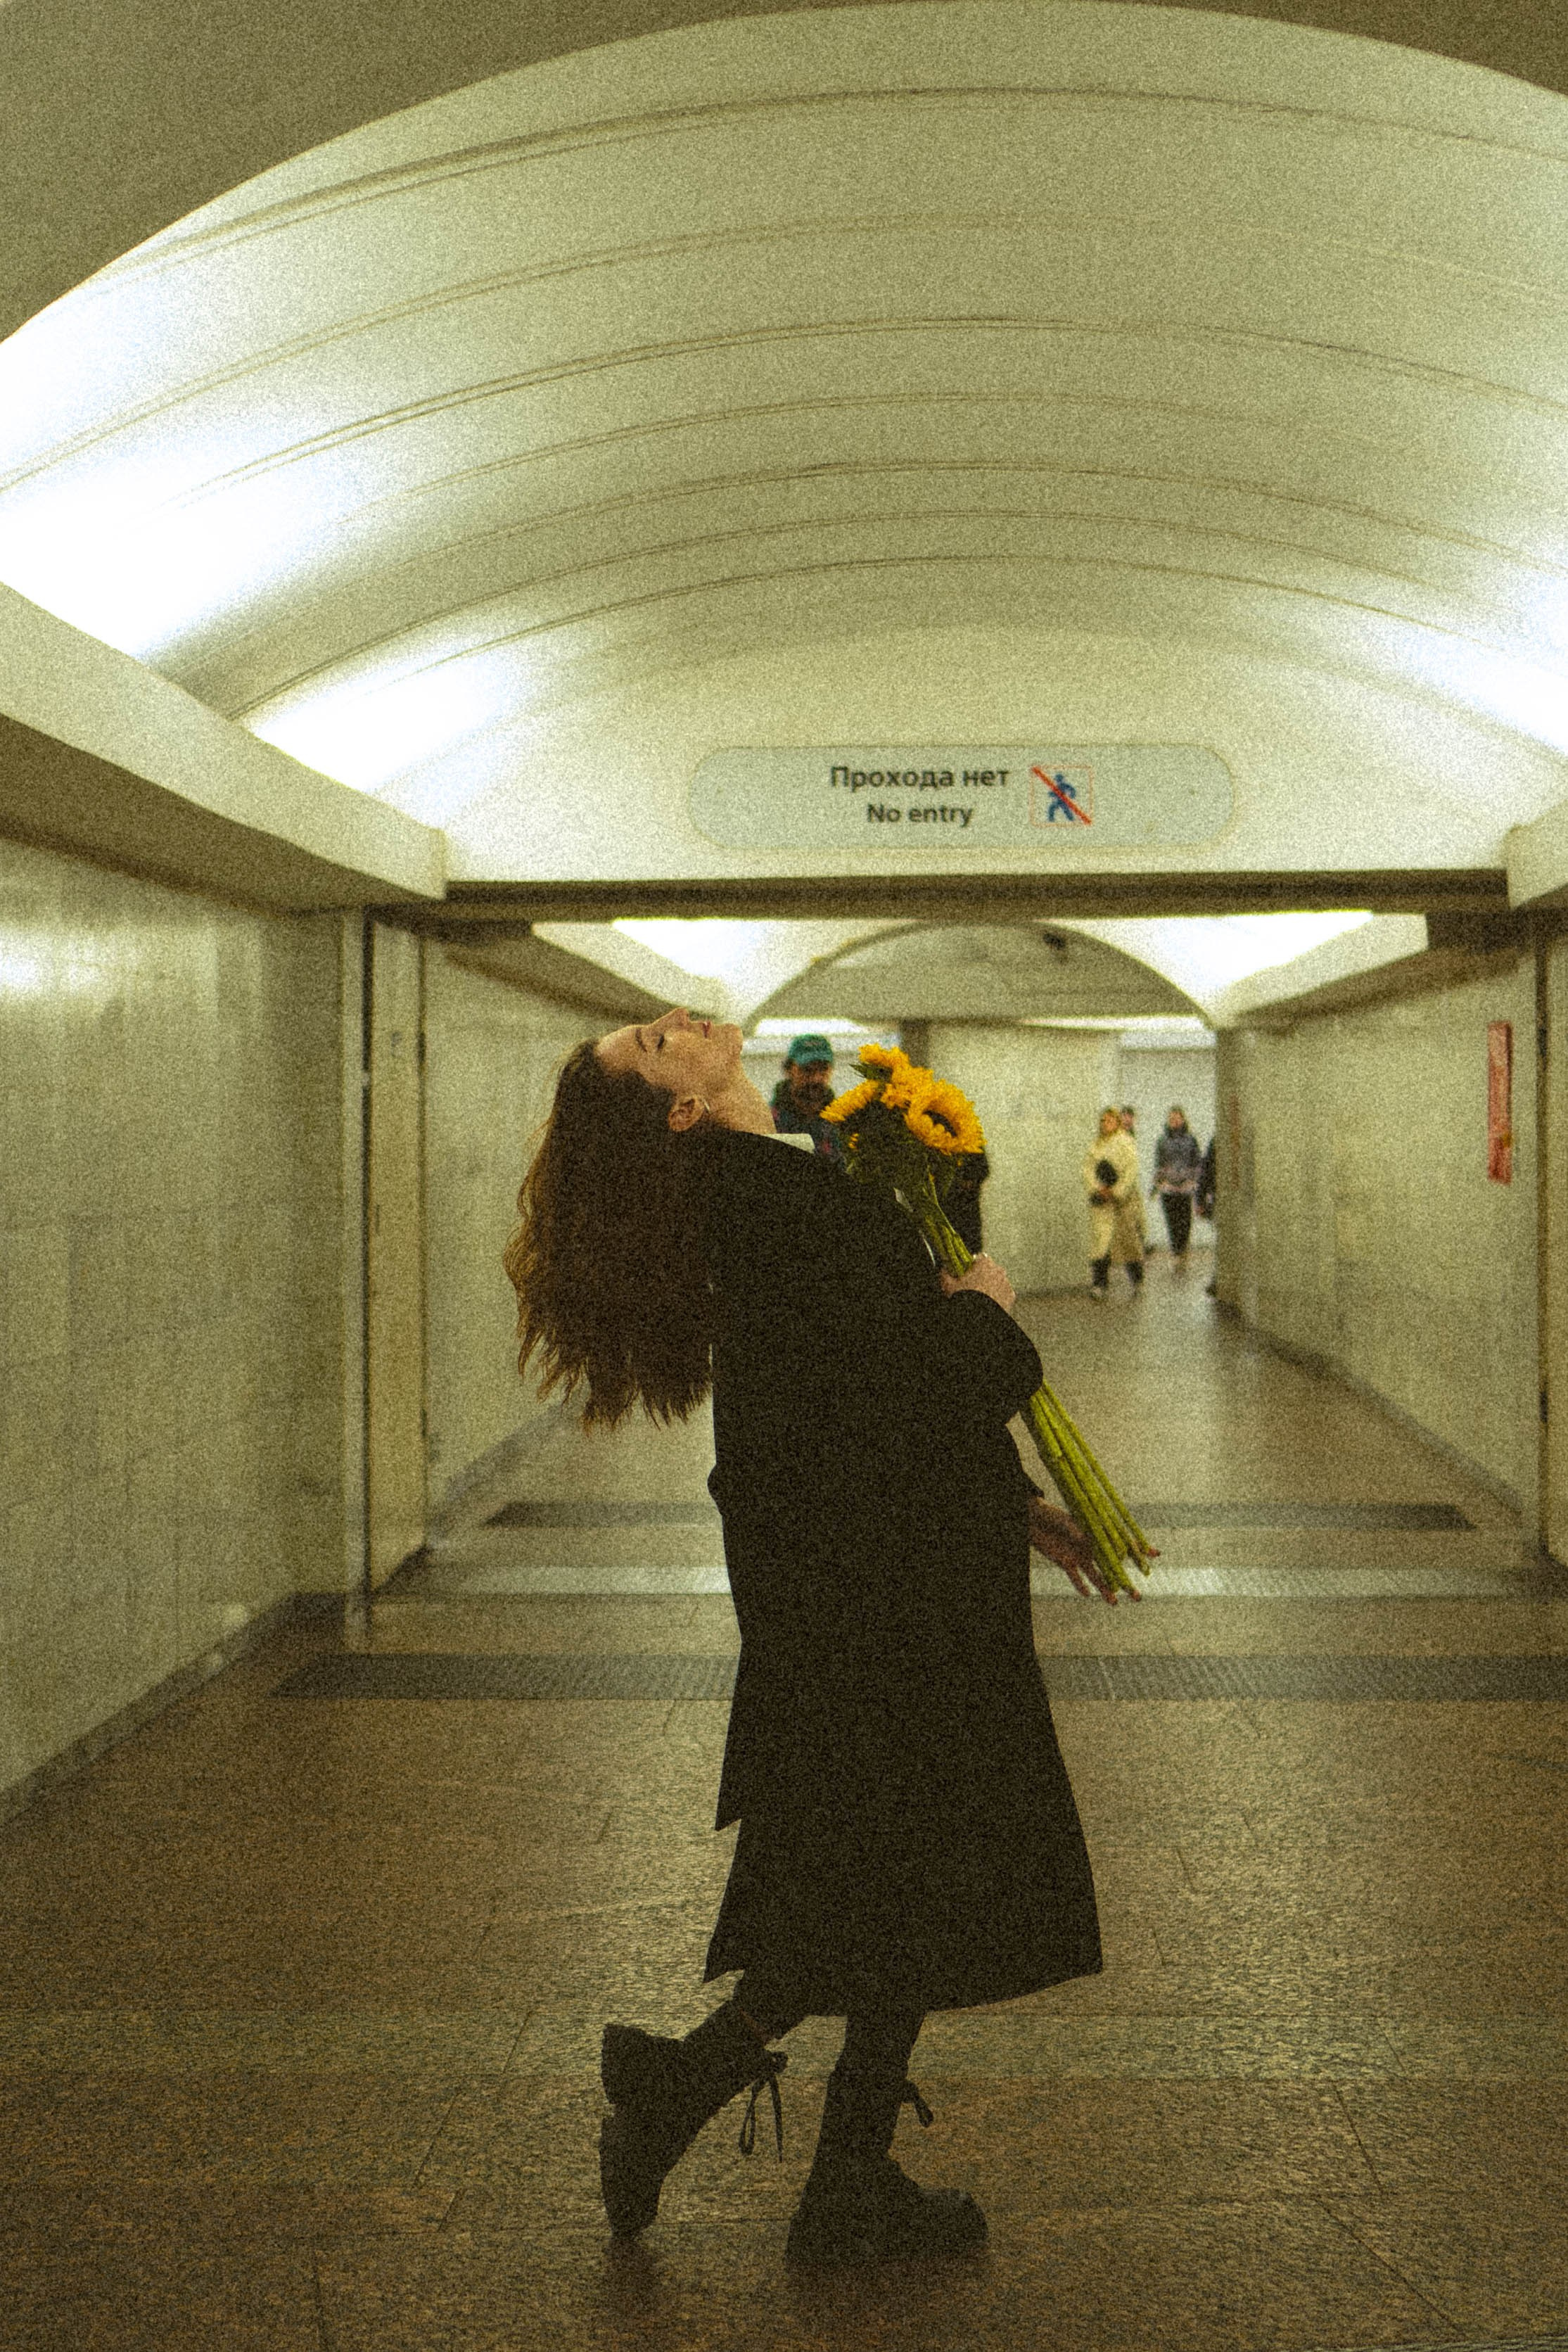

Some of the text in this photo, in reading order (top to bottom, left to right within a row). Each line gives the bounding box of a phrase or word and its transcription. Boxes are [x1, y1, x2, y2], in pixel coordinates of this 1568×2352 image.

[831, 765, 1009, 792] Прохода нет
[867, 805, 973, 827] No entry
